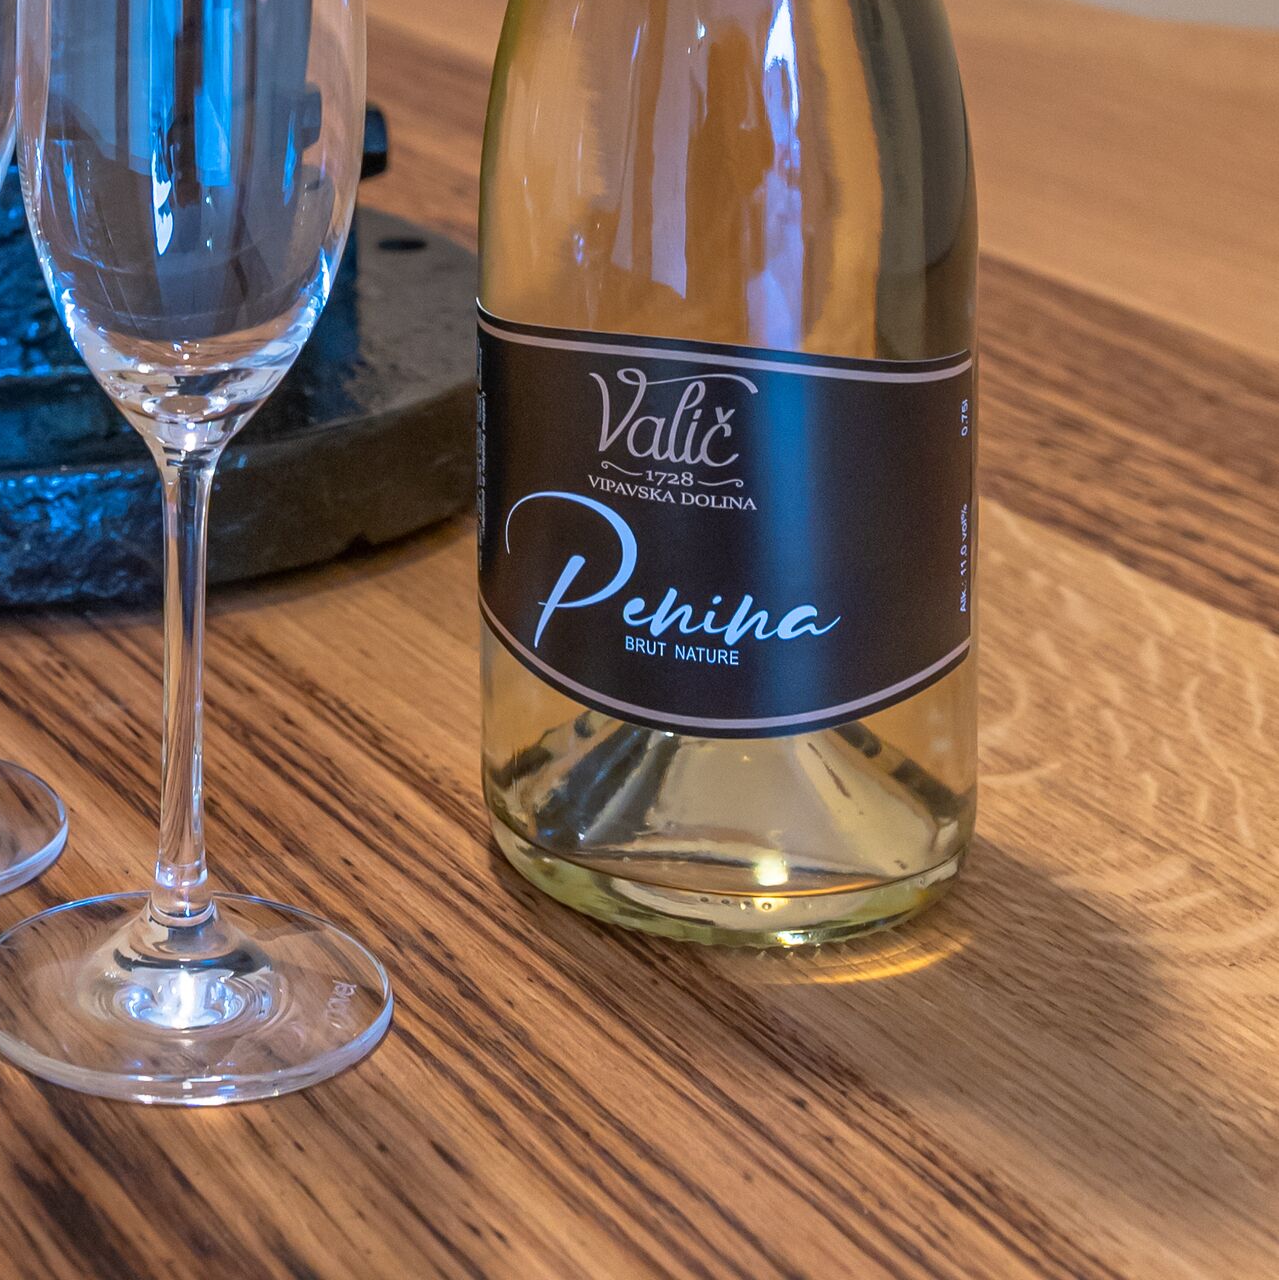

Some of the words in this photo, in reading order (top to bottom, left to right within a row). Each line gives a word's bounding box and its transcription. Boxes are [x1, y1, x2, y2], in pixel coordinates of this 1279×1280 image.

[589, 368, 758, 467] Valič
[588, 474, 675, 503] VIPAVSKA
[681, 492, 757, 511] DOLINA
[645, 470, 694, 487] 1728
[506, 491, 841, 648] Penina
[625, 635, 666, 656] BRUT
[675, 644, 739, 665] NATURE
